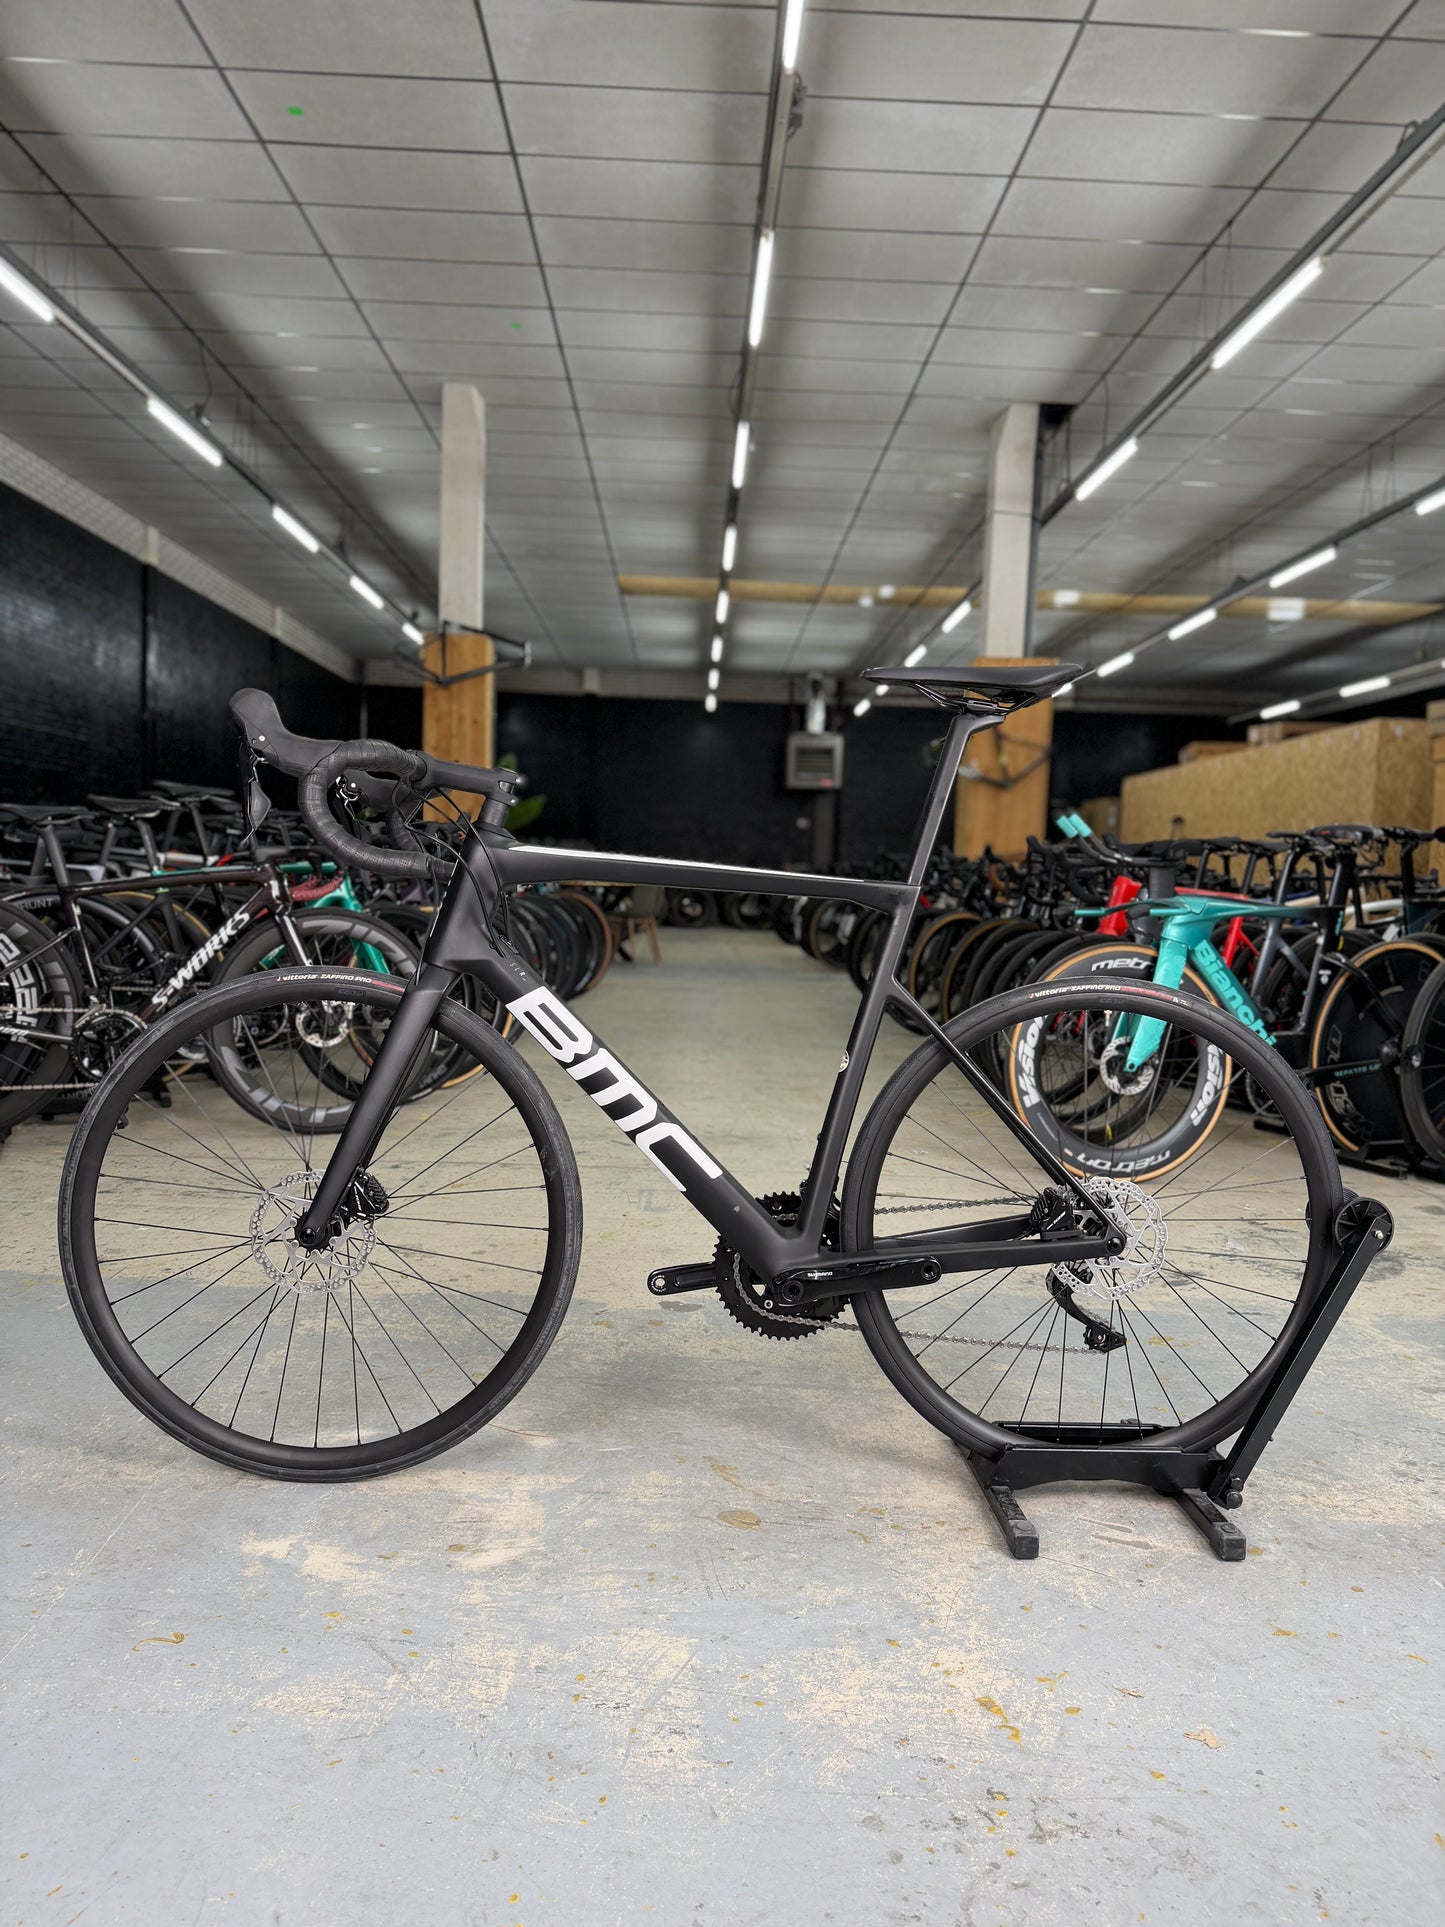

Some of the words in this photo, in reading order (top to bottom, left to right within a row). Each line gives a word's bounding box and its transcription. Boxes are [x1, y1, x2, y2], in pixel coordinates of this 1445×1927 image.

[152, 905, 251, 1012] S-WORKS
[282, 974, 318, 982] vittoria
[1090, 957, 1153, 972] metr
[1034, 986, 1068, 998] vittoria
[1194, 943, 1278, 1047] Bianchi
[505, 985, 723, 1192] BMC
